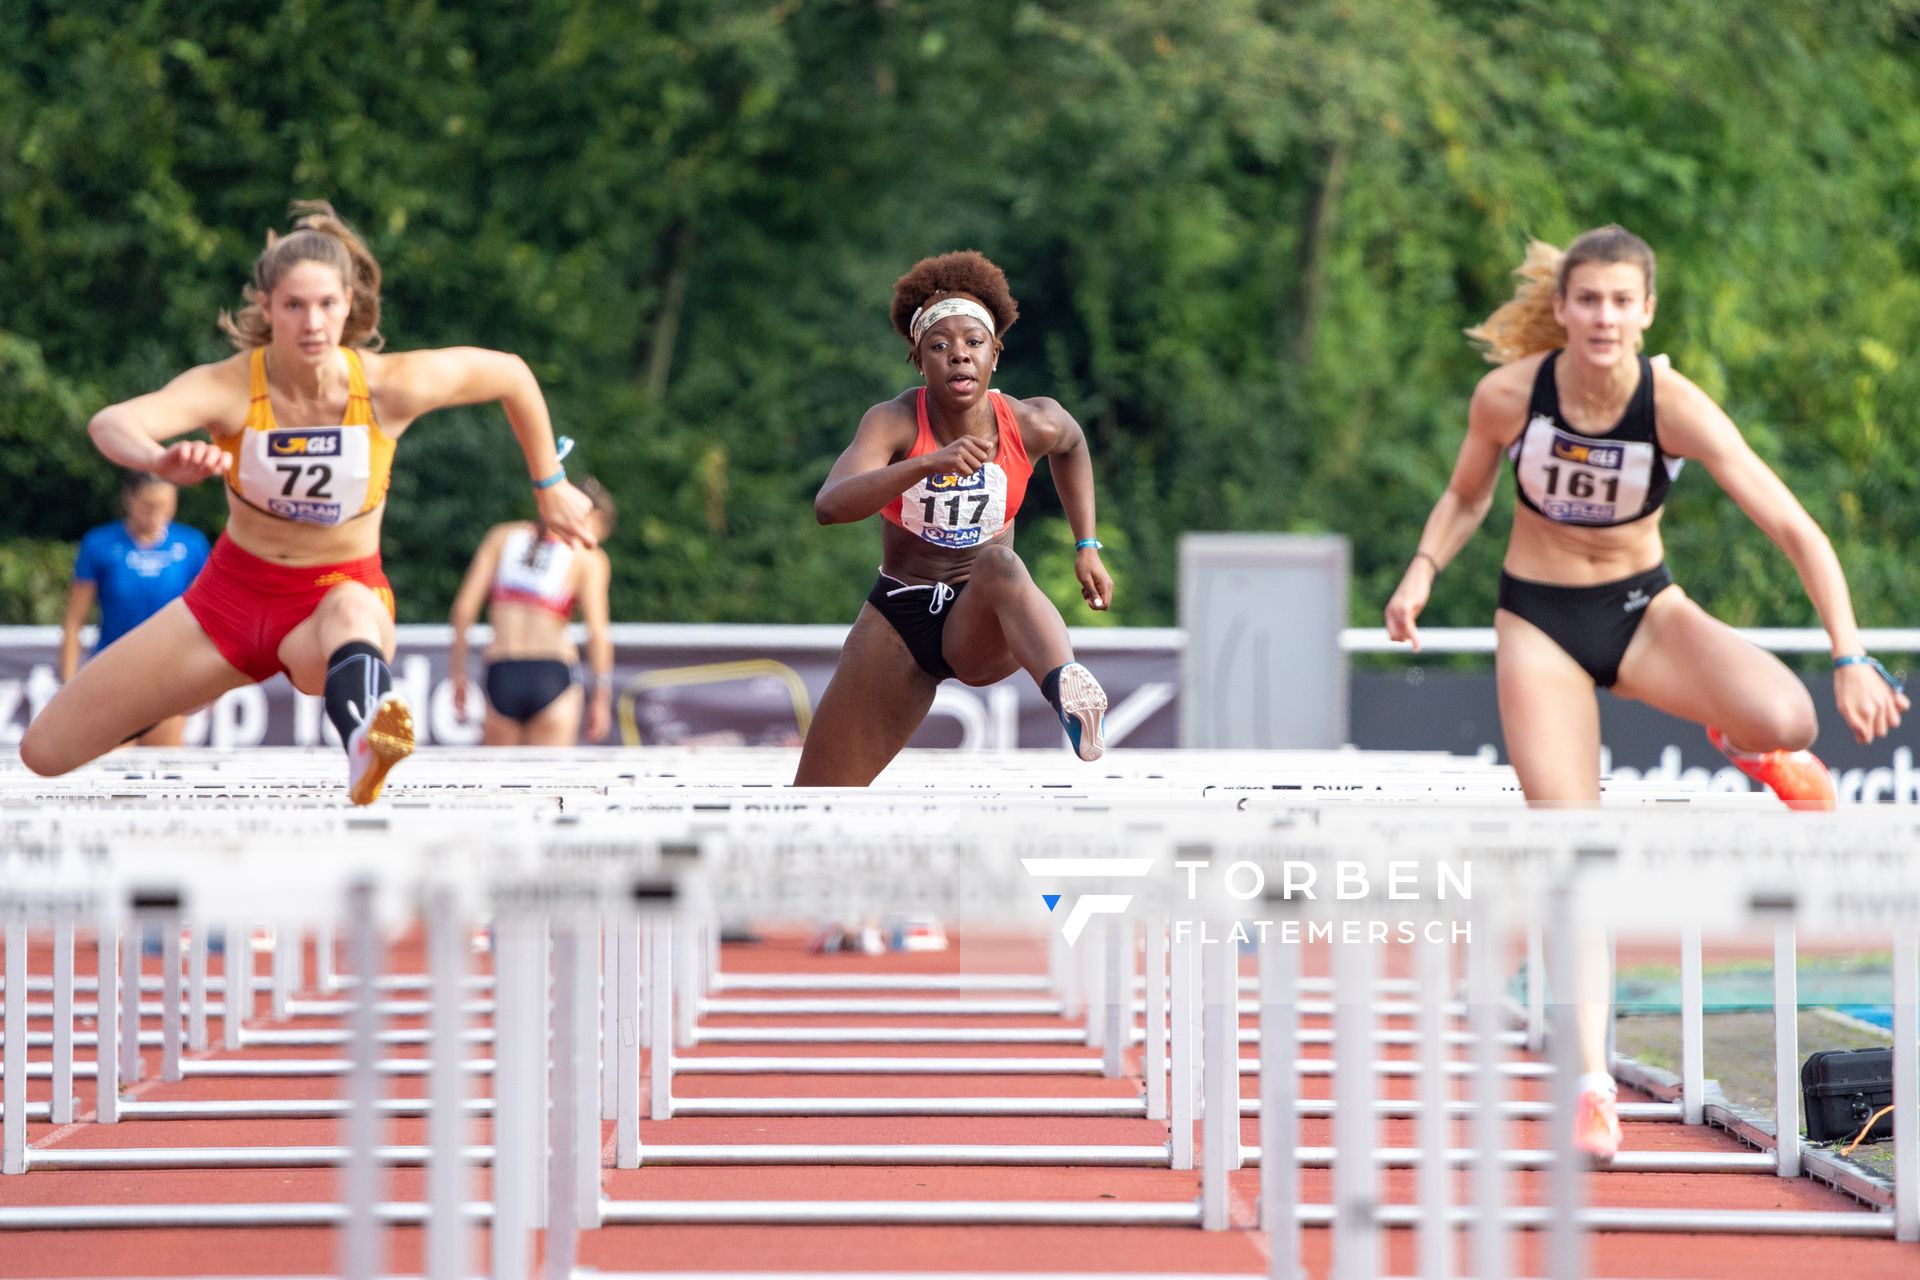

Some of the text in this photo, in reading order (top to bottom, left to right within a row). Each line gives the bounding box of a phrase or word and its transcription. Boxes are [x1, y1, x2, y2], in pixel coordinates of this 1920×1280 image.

[307, 436, 337, 454] GLS
[1588, 449, 1619, 468] GLS
[276, 463, 333, 499] 72
[1543, 465, 1619, 502] 161
[298, 503, 338, 516] PLAN
[920, 494, 990, 526] 117
[946, 530, 978, 541] PLAN
